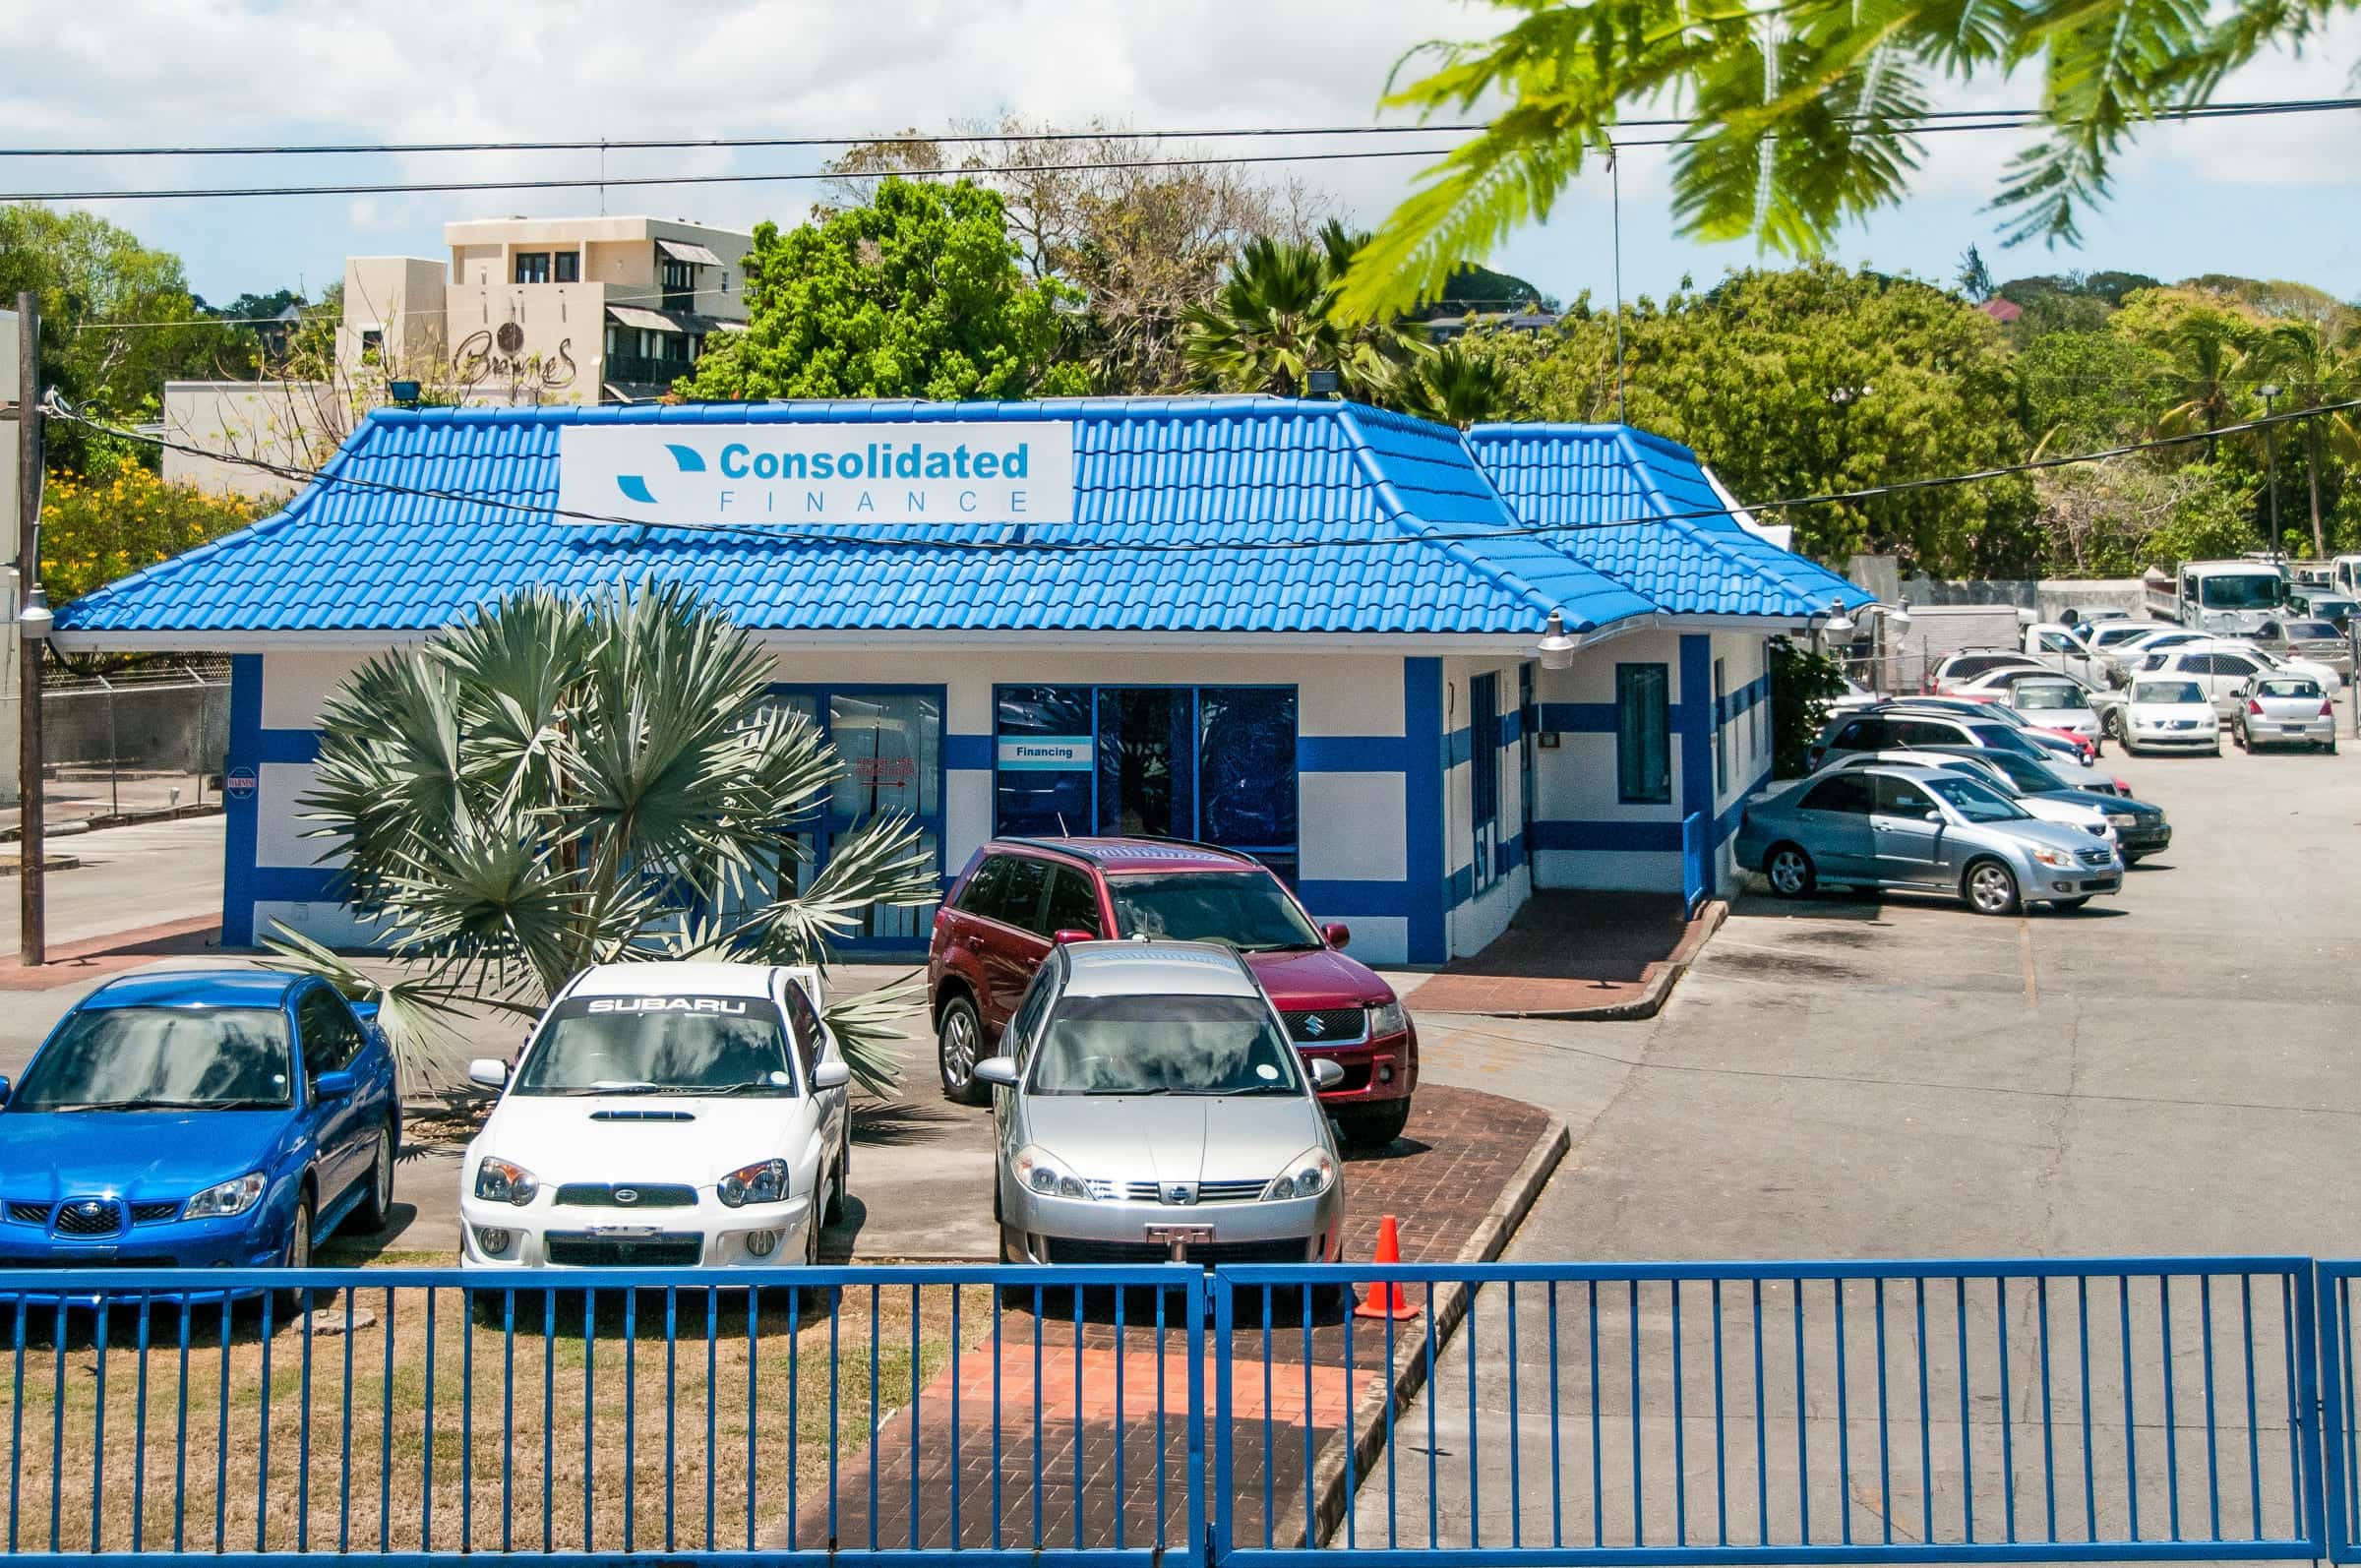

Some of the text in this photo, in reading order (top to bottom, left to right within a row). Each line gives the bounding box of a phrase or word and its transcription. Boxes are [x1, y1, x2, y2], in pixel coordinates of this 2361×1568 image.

[720, 443, 1028, 479] Consolidated
[720, 492, 1027, 513] FINANCE
[1016, 747, 1073, 758] Financing
[588, 997, 747, 1014] SUBARU
